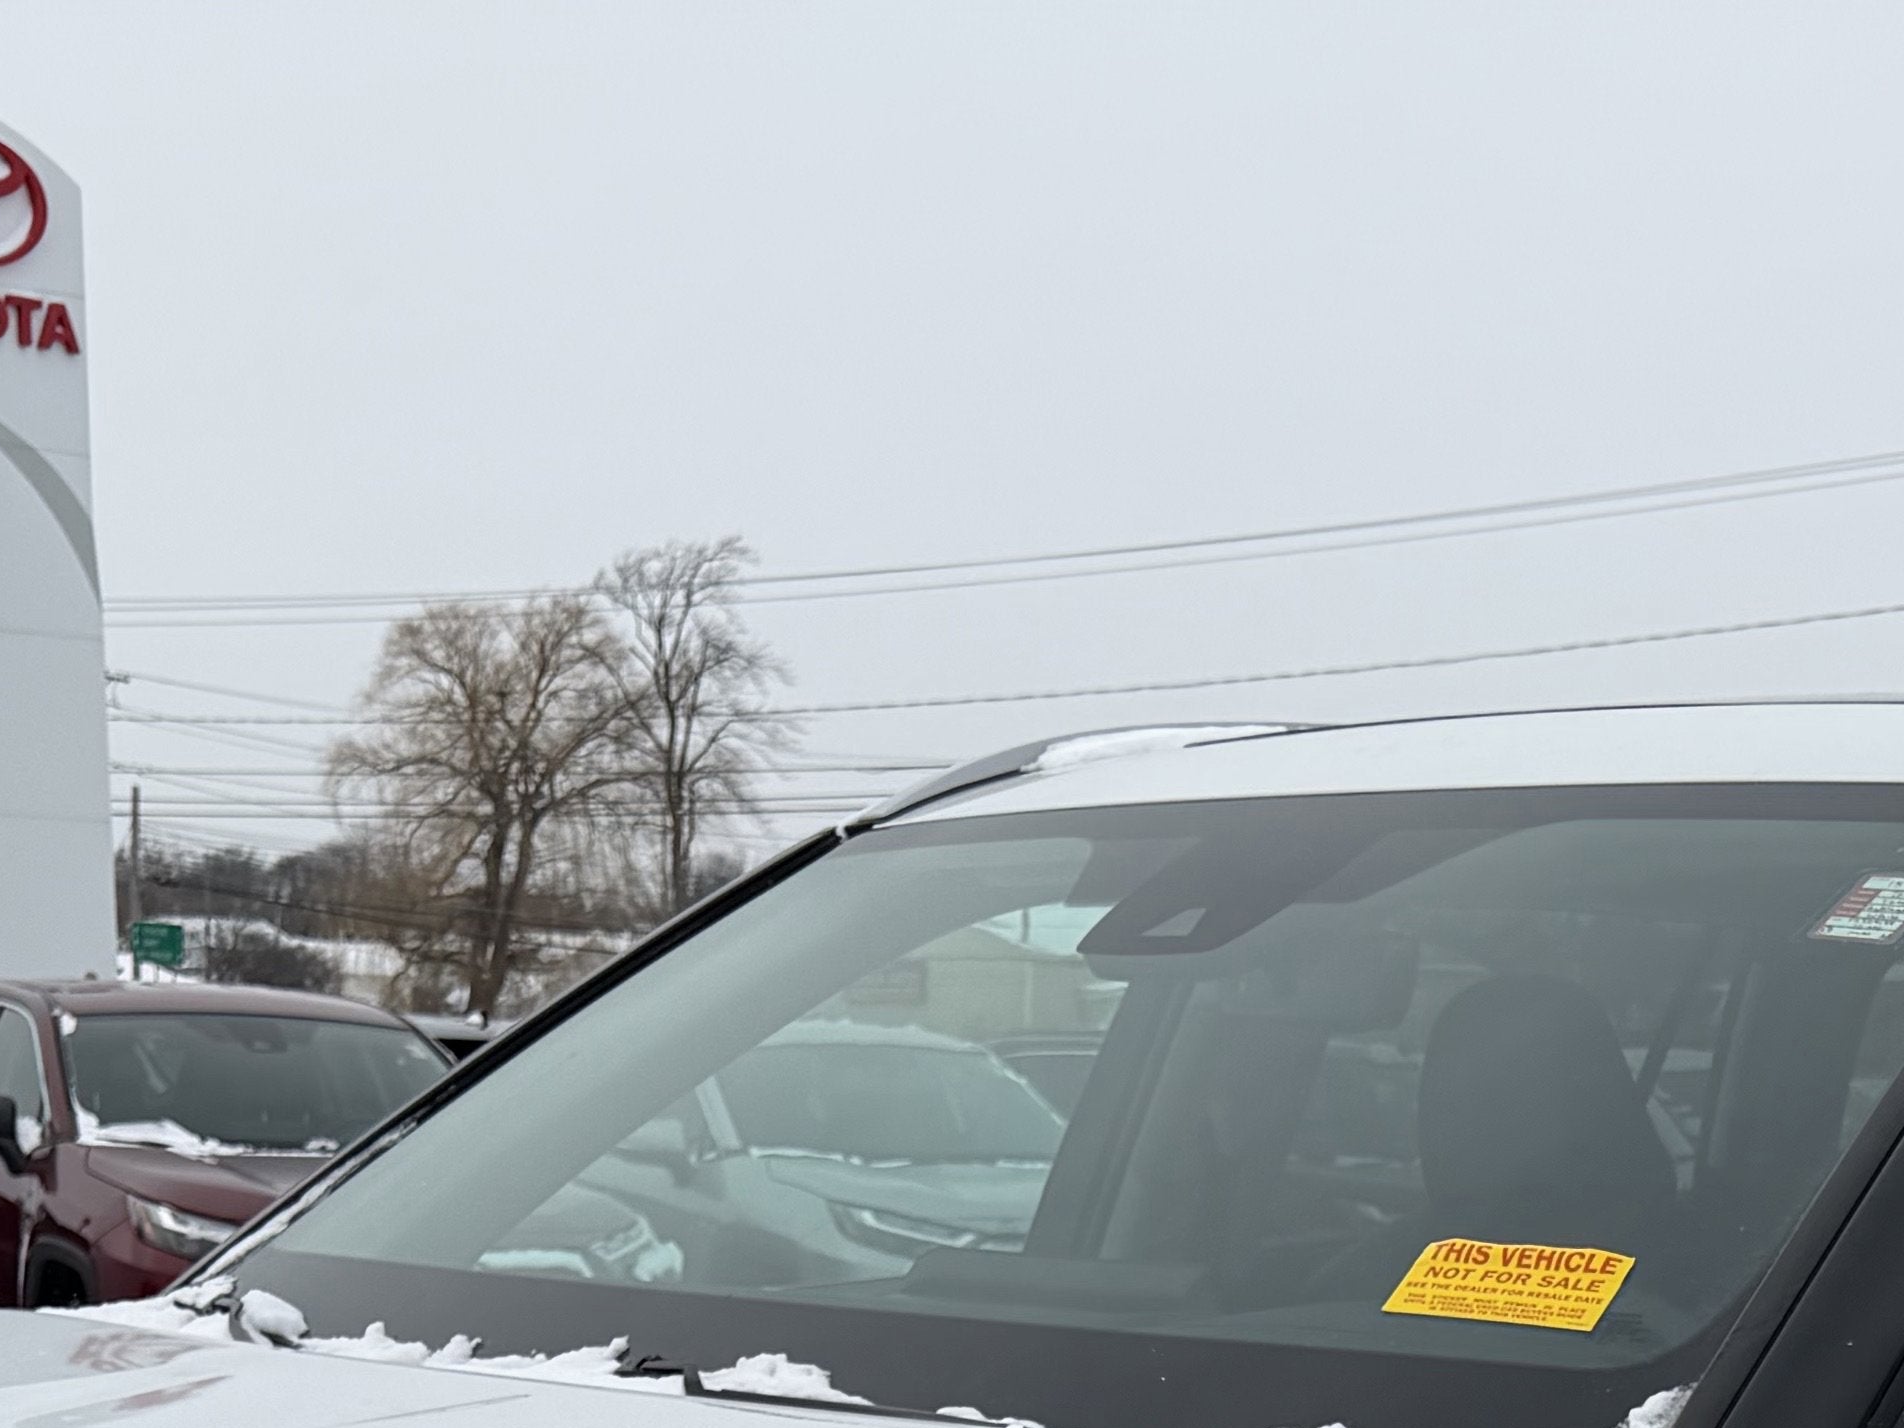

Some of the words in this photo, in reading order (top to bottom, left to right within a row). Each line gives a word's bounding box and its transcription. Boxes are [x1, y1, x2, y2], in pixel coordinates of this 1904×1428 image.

[1431, 1243, 1493, 1265] THIS
[1502, 1247, 1623, 1275] VEHICLE
[1405, 1281, 1428, 1289] SEE
[1431, 1282, 1453, 1291] THE
[1453, 1284, 1499, 1294] DEALER
[1500, 1288, 1524, 1297] FOR
[1526, 1291, 1572, 1301] RESALE
[1574, 1296, 1604, 1305] DATE
[1424, 1266, 1477, 1281] NOT
[1479, 1271, 1532, 1286] FOR
[1537, 1275, 1606, 1293] SALE
